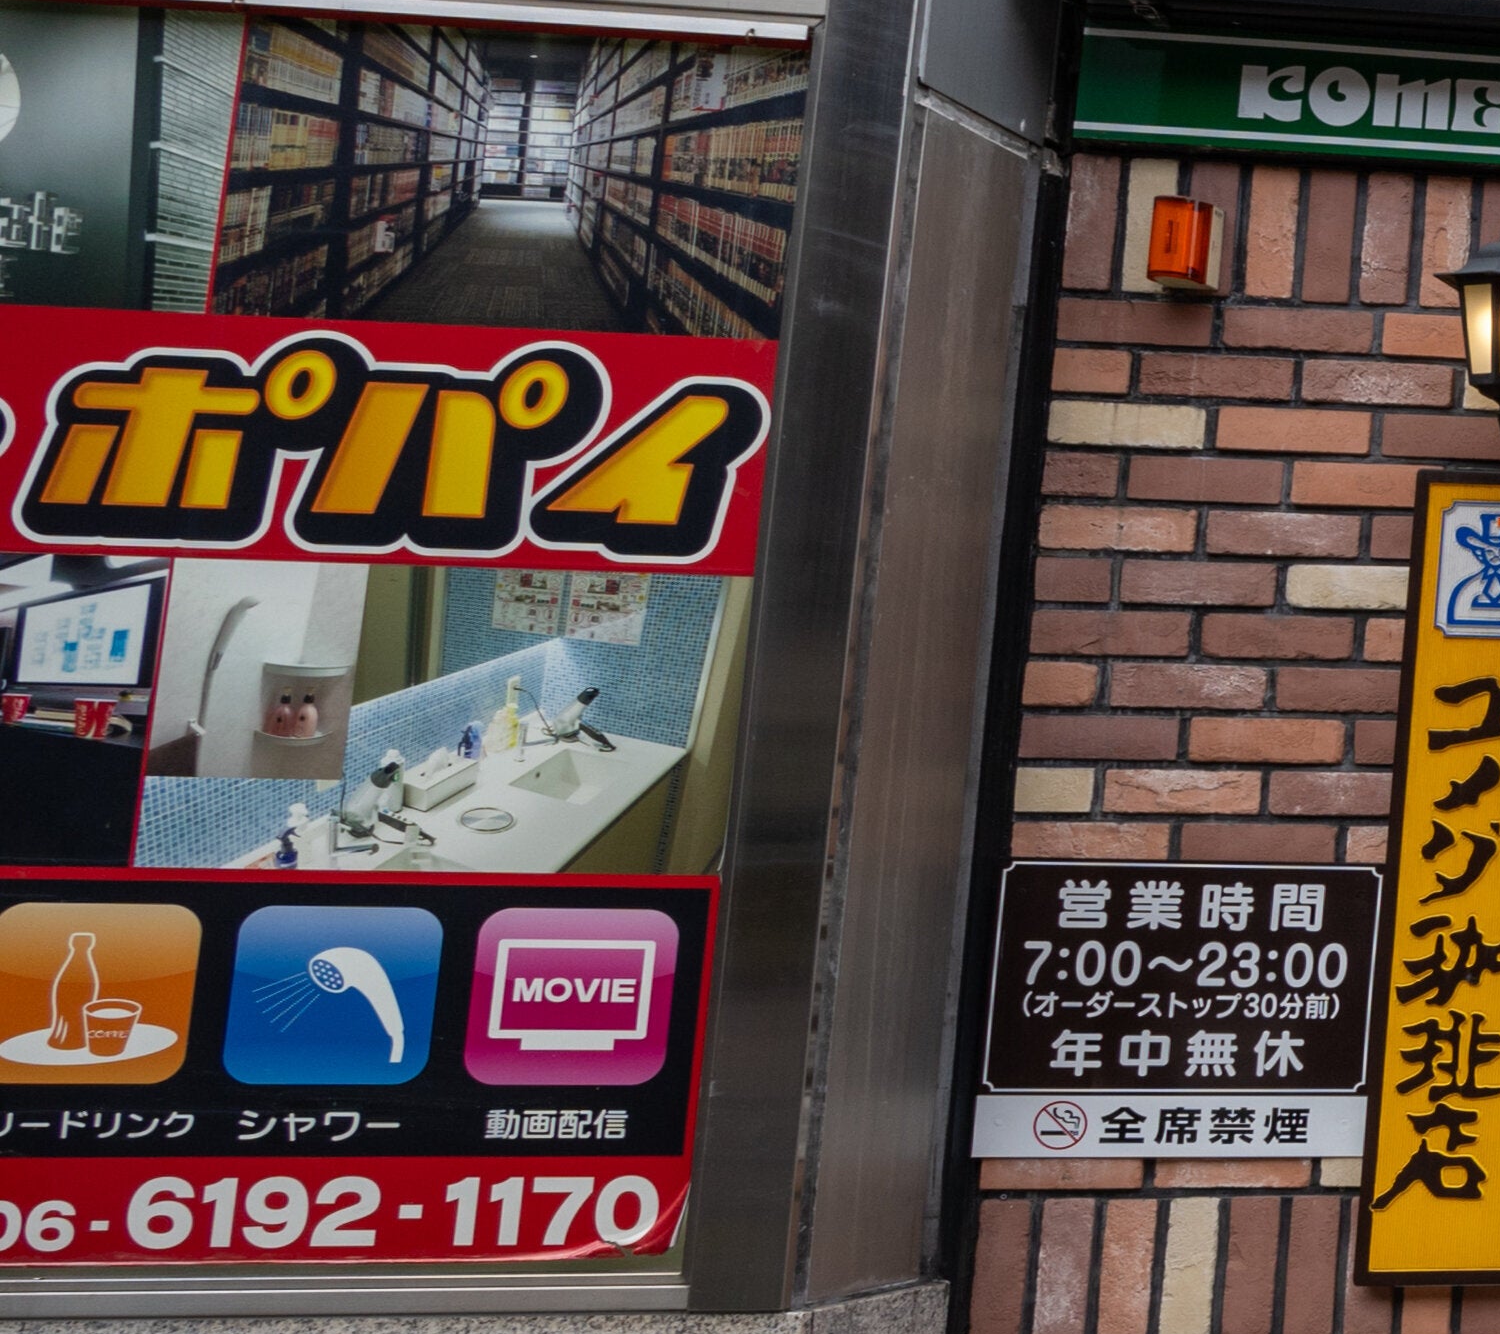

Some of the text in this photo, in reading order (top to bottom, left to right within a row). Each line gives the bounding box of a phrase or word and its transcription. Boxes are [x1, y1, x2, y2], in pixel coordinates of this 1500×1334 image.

[38, 349, 729, 528] ポパイ
[1056, 878, 1327, 934] 営業時間
[511, 977, 638, 1003] MOVIE
[1050, 1029, 1307, 1079] 年中無休
[237, 1108, 628, 1142] シャワー 動画配信
[1098, 1106, 1313, 1145] 全席禁煙
